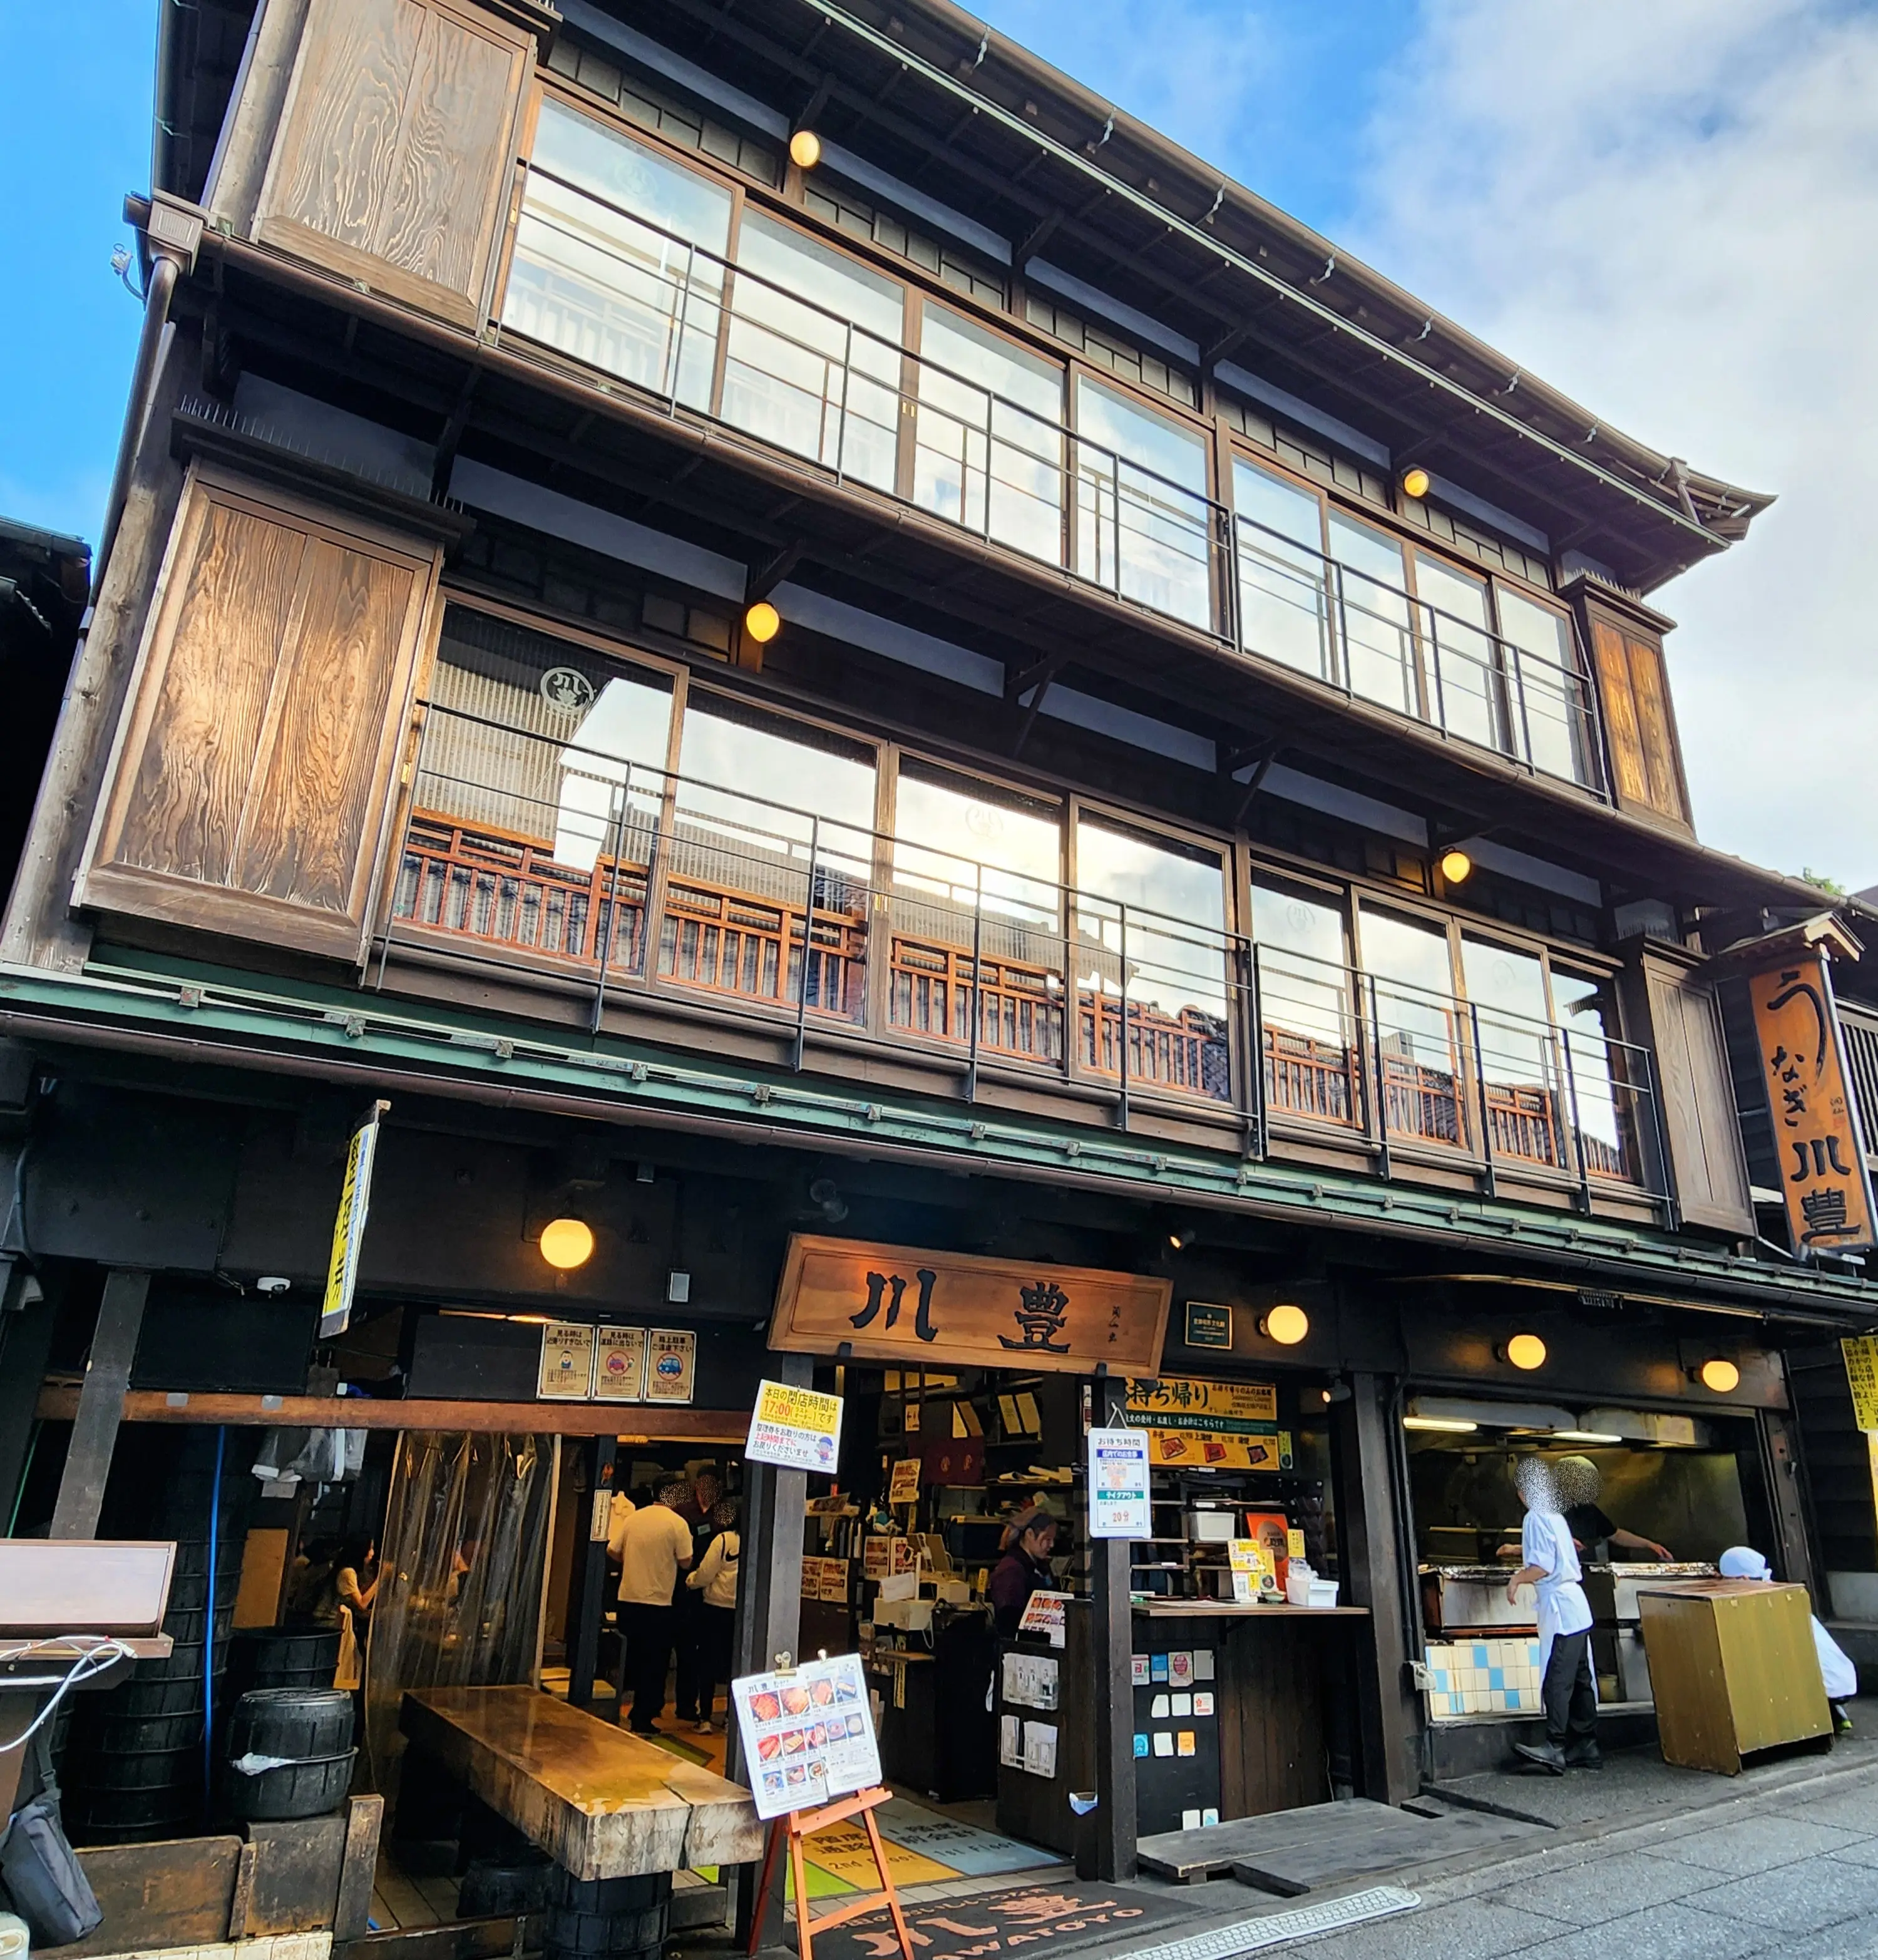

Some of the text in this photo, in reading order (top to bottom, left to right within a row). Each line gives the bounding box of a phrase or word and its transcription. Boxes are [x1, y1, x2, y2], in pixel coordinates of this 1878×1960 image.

[765, 1387, 838, 1413] 本日の閉店時間は
[1125, 1377, 1208, 1409] 持ち帰り
[764, 1400, 791, 1417] 17:00
[1097, 1438, 1141, 1447] お待ち時間
[1106, 1491, 1137, 1500] テイクアウト
[828, 1854, 918, 1870] 2nd Foor
